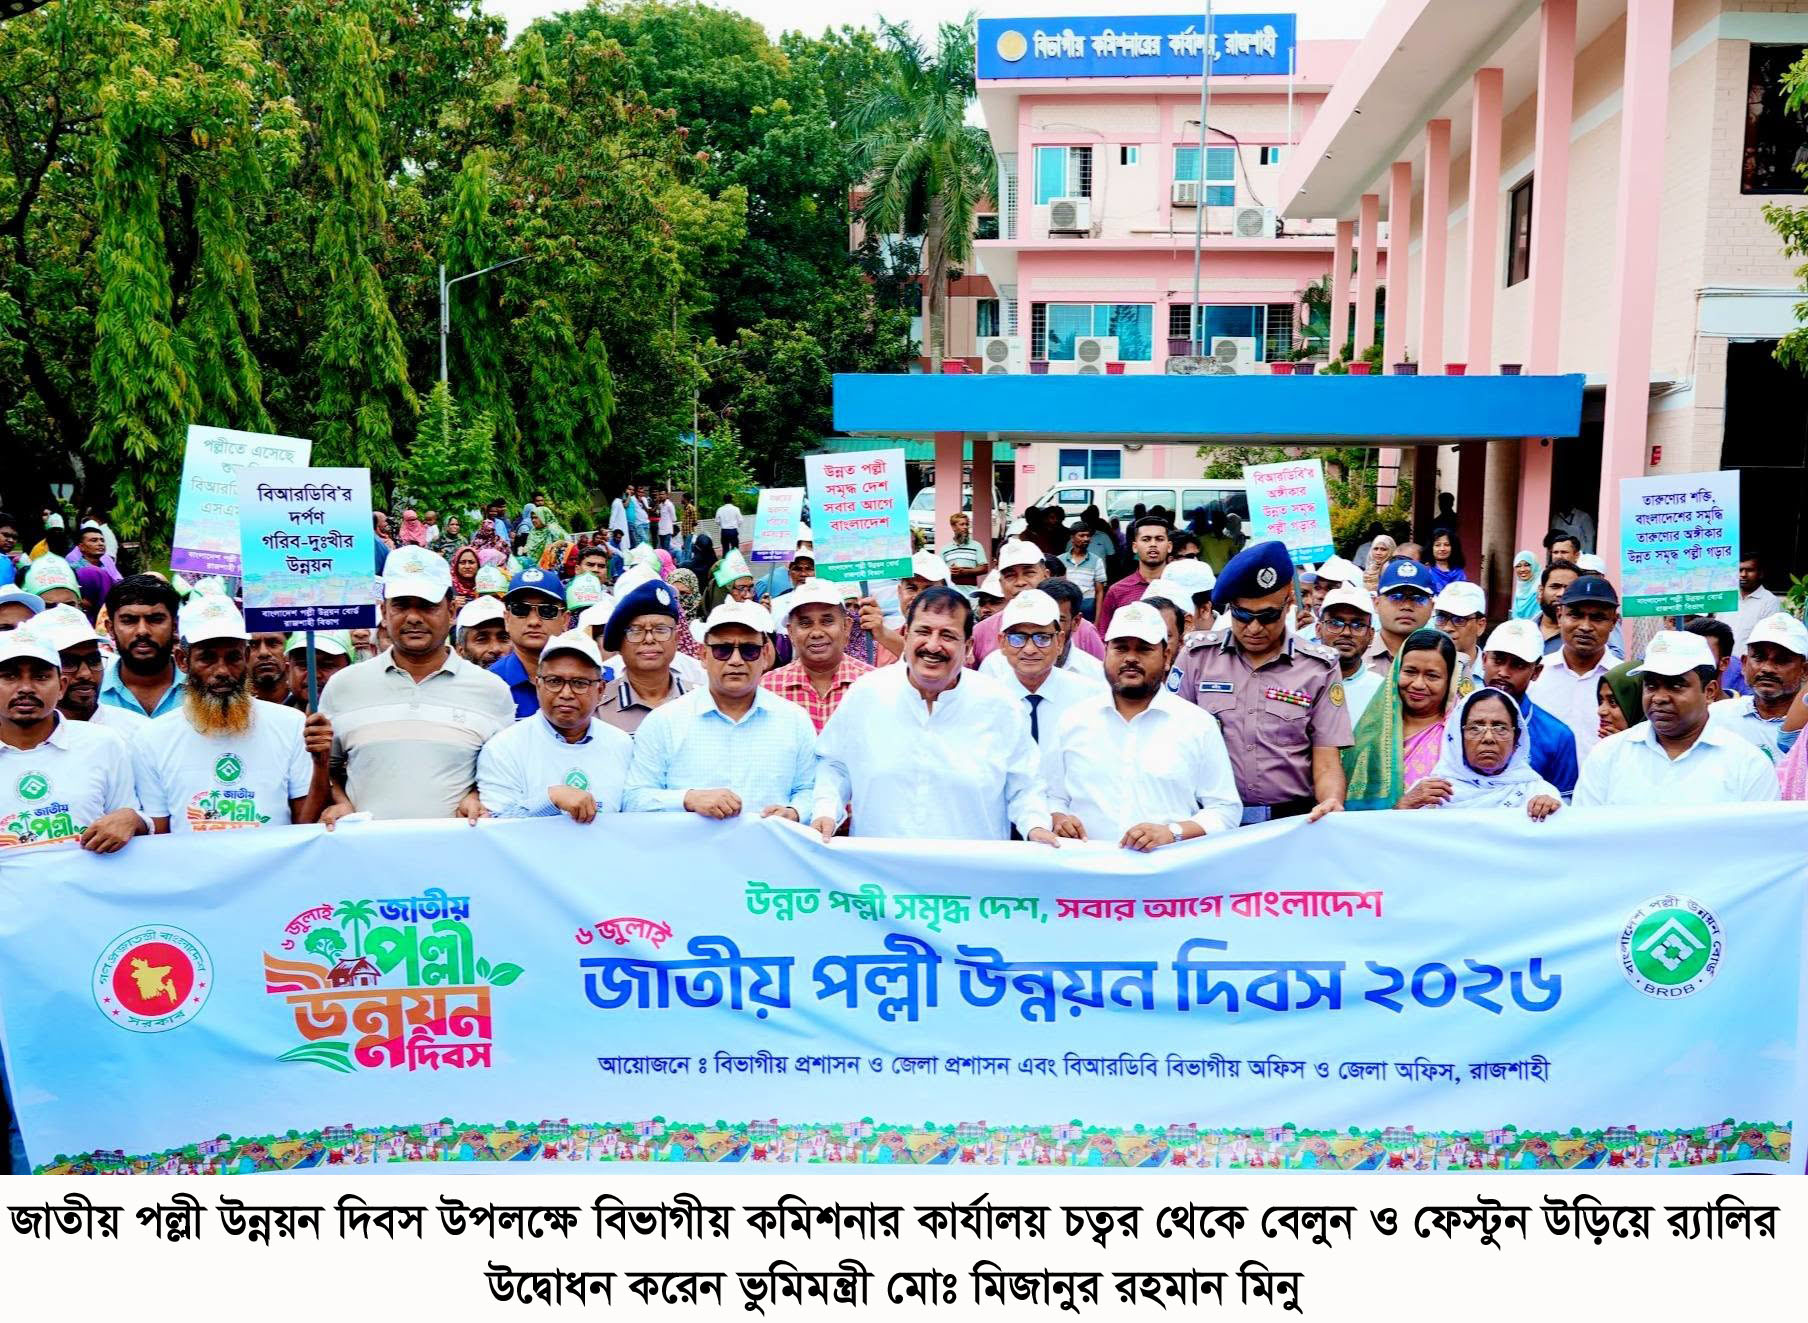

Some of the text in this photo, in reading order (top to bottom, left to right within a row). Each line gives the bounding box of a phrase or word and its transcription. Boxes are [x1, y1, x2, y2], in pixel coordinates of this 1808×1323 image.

[1224, 25, 1278, 58] রাজশাহী
[824, 459, 887, 479] উন্নত পল্লী
[825, 480, 888, 499] সমৃদ্ধ দেশ
[1642, 493, 1687, 505] তারুণ্যের
[824, 498, 894, 513] সবার আগে
[1635, 506, 1724, 526] বাংলাদেশের সমৃদ্ধি
[289, 507, 325, 526] দর্পণ
[829, 517, 890, 532] বাংলাদেশ
[261, 530, 354, 553] গরিব-দুঃখীর
[1636, 525, 1723, 543] তারুণ্যের অঙ্গীকার
[1627, 543, 1732, 564] উন্নত সমৃদ্ধ পল্লী গড়ার
[286, 556, 333, 575] উন্নয়ন
[377, 887, 470, 923] জাতীয়
[746, 881, 1384, 933] উন্নত পল্লী সমৃদ্ধ দেশ, সবার আগে বাংলাদেশ
[284, 904, 334, 935] জুলাই
[575, 917, 673, 949] ৬ জুলাই
[364, 919, 475, 986] পল্লী
[580, 933, 1562, 1022] জাতীয় পল্লী উন্নয়ন দিবস ২০২৬
[1644, 984, 1695, 997] BRDB
[406, 1034, 492, 1071] দিবস
[598, 1056, 690, 1075] আয়োজনে
[714, 1049, 788, 1074] বিভাগীয়
[795, 1057, 861, 1075] প্রশাসন
[868, 1059, 882, 1074] ও
[891, 1056, 939, 1075] জেলা
[944, 1056, 1010, 1077] প্রশাসন
[1018, 1058, 1056, 1077] এবং
[1063, 1052, 1159, 1077] বিআরডিবি
[1167, 1053, 1240, 1078] বিভাগীয়
[1247, 1054, 1306, 1080] অফিস
[1314, 1062, 1329, 1079] ও
[1339, 1061, 1387, 1080] জেলা
[1395, 1056, 1461, 1085] অফিস,
[1469, 1055, 1551, 1082] রাজশাহী
